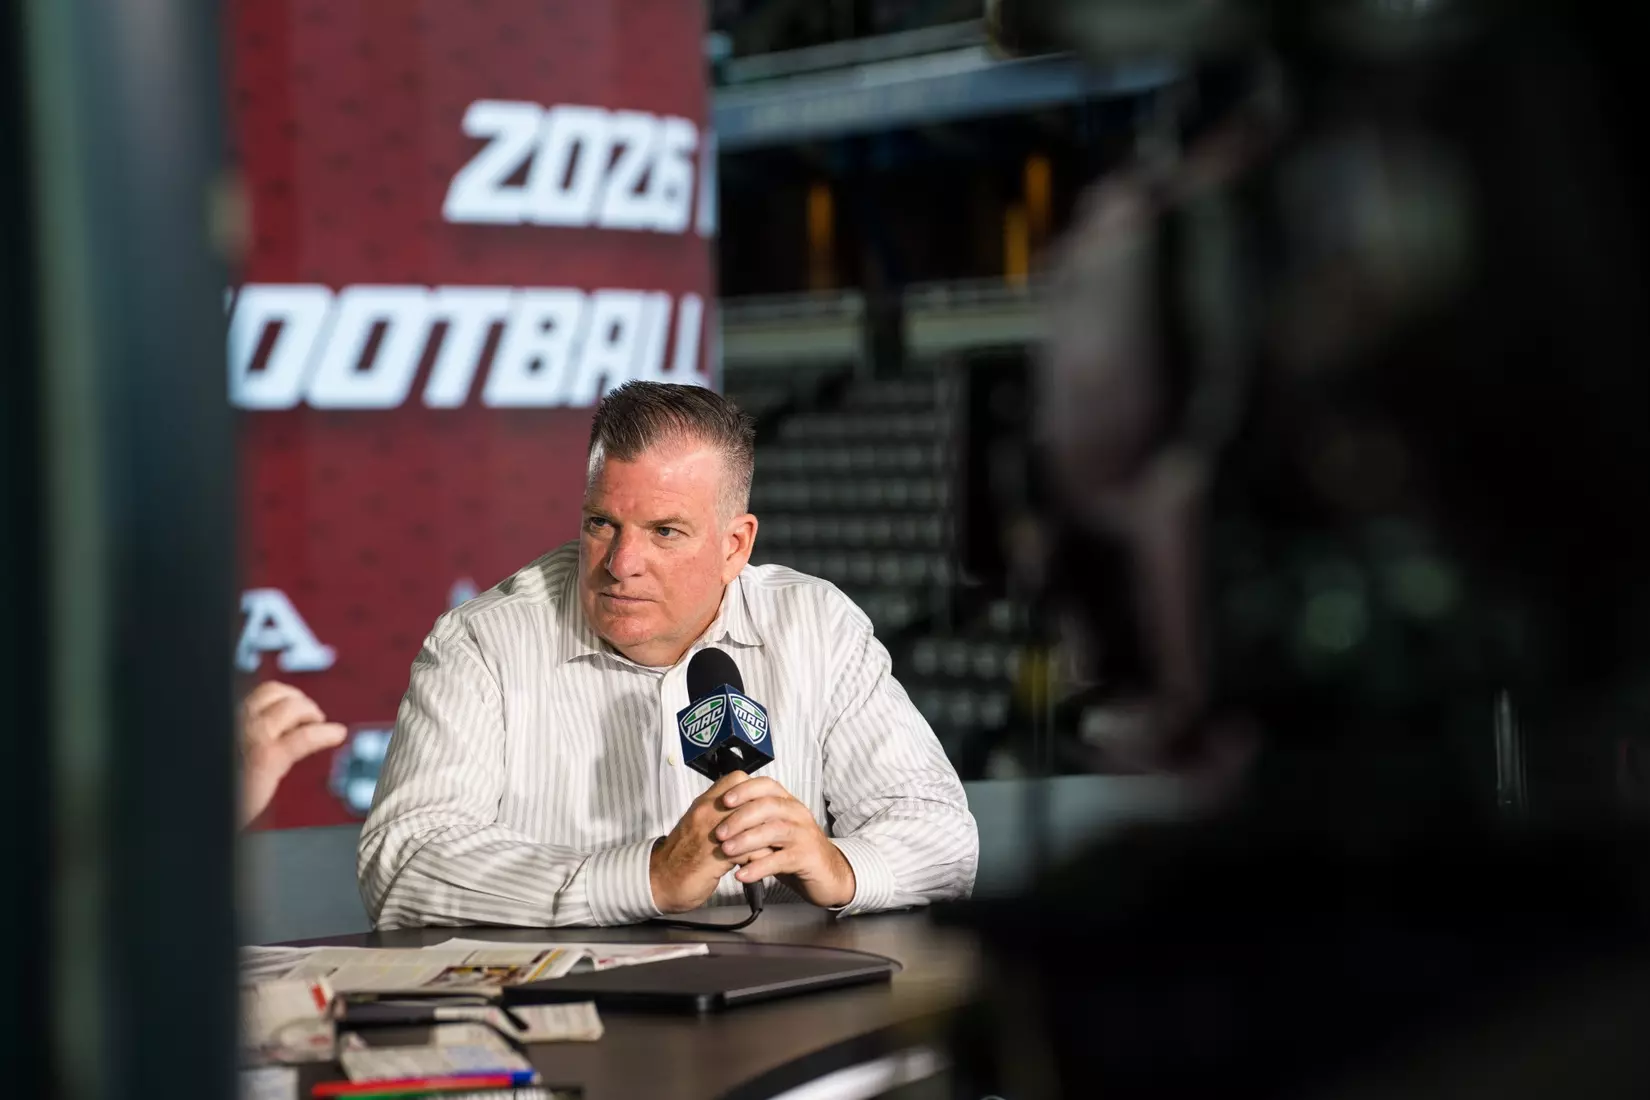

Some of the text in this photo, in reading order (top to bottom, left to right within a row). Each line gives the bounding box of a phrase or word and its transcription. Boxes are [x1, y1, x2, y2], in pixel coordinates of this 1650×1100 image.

[442, 99, 699, 234] 2026
[224, 283, 710, 410] OOTBALL
[686, 705, 724, 737] MAC
[734, 705, 765, 730] MAC
